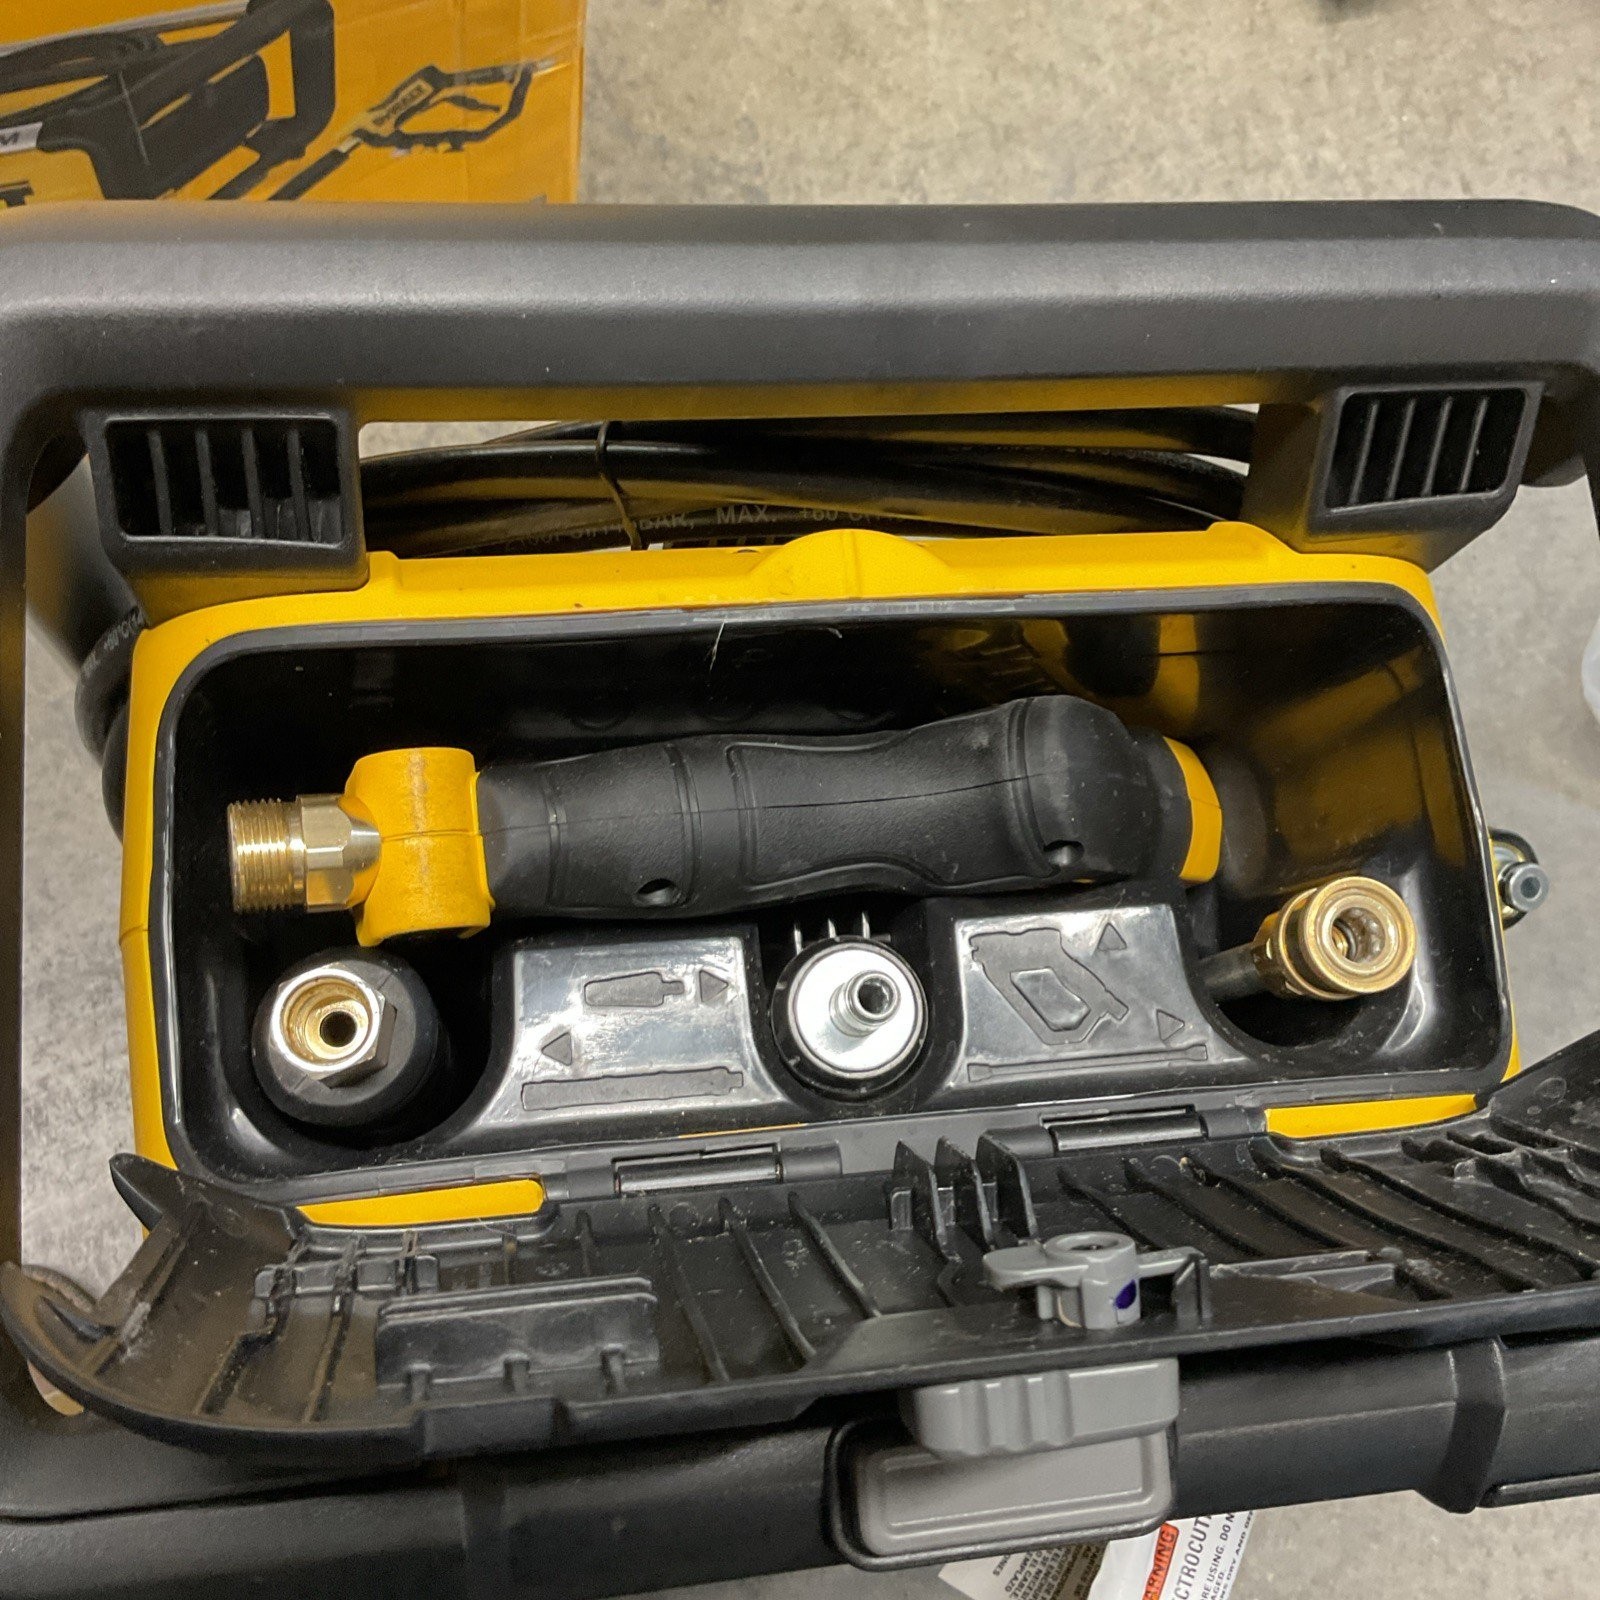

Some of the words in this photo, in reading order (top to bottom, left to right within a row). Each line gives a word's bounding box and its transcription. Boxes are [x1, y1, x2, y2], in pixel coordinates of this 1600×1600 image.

[716, 504, 777, 525] MAX.
[1220, 1524, 1231, 1541] DO
[1235, 1531, 1246, 1556] AND
[1172, 1515, 1212, 1600] CTROCUT
